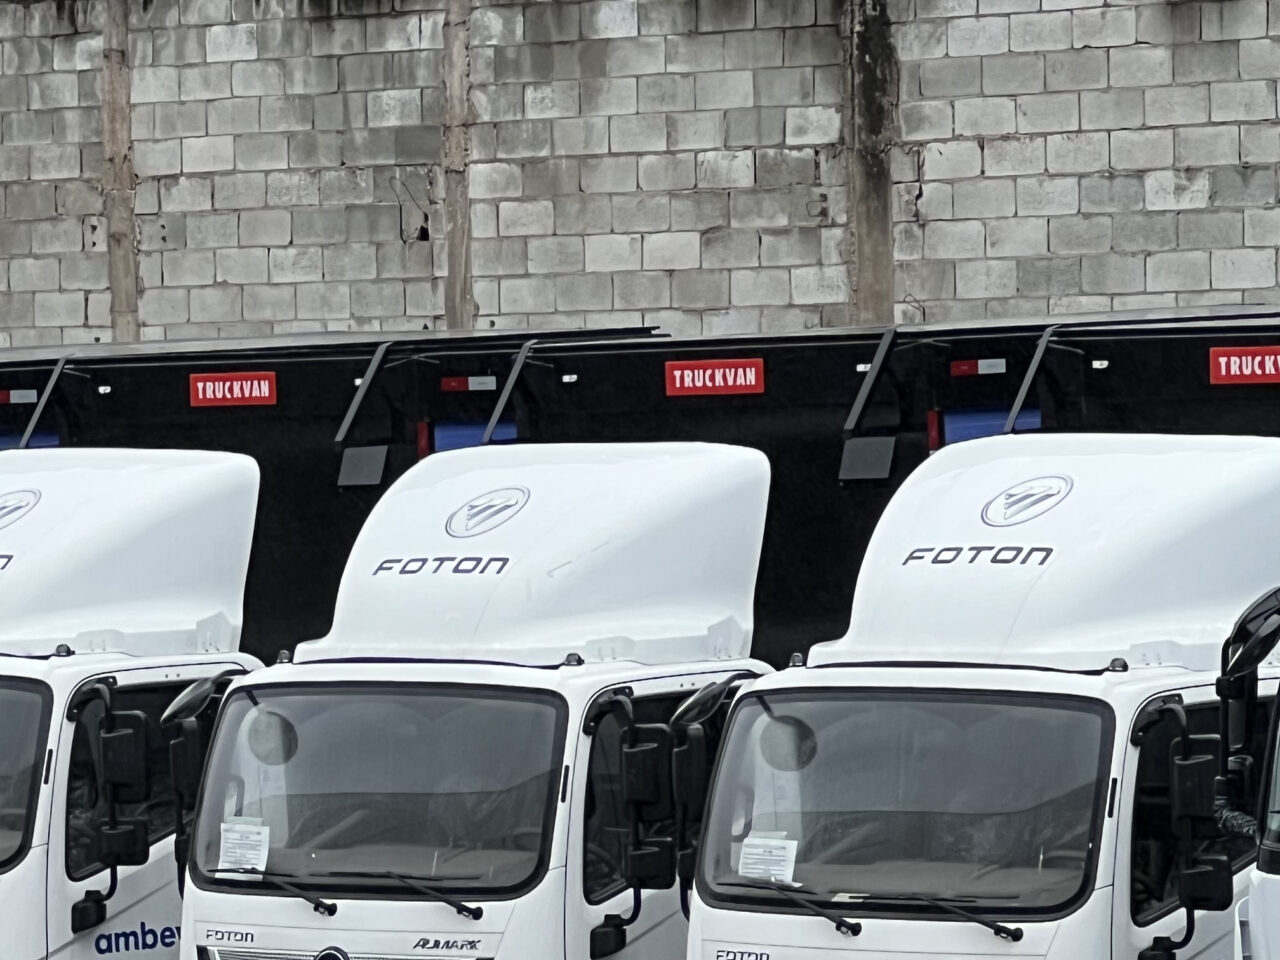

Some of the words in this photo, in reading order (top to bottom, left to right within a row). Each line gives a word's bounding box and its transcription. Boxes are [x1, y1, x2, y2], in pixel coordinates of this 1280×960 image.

[1218, 355, 1280, 376] TRUCK
[673, 367, 756, 388] TRUCKVAN
[197, 380, 269, 399] TRUCKVAN
[901, 546, 1053, 565] FOTON
[372, 556, 510, 576] FOTON
[206, 929, 254, 943] FOTON
